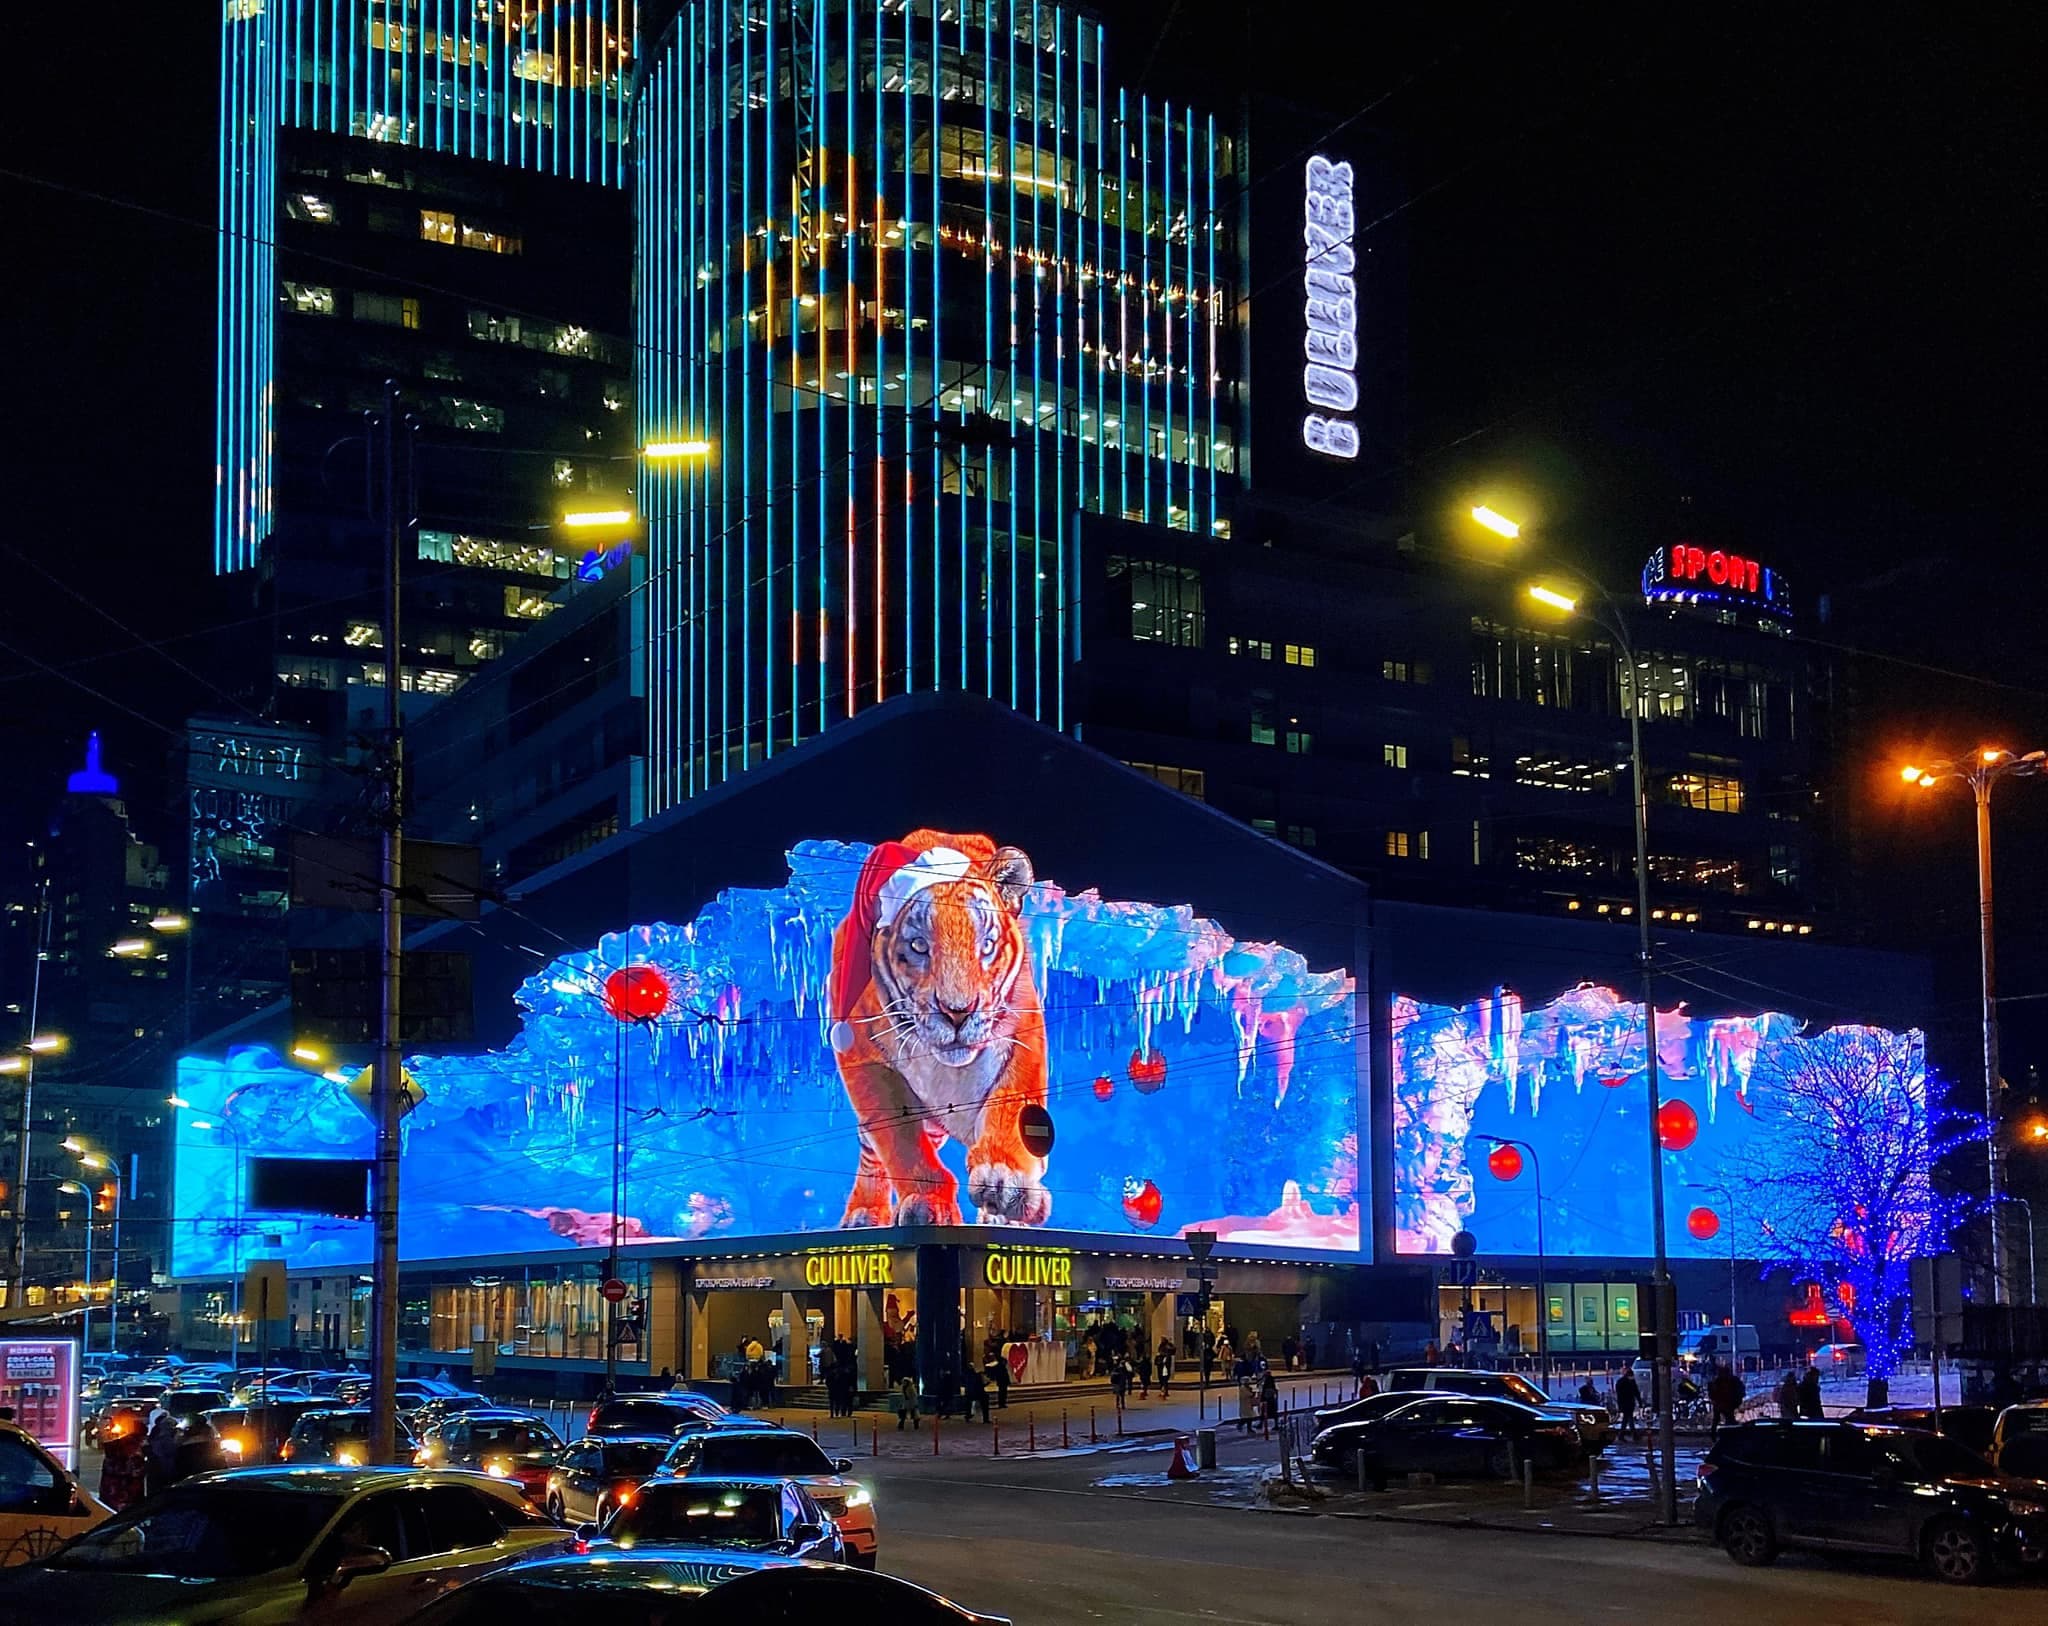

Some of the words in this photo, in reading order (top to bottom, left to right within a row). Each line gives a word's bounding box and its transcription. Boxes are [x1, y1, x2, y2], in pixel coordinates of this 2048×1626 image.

[1672, 544, 1761, 593] SPORT
[805, 1253, 892, 1287] GULLIVER
[985, 1253, 1072, 1287] GULLIVER
